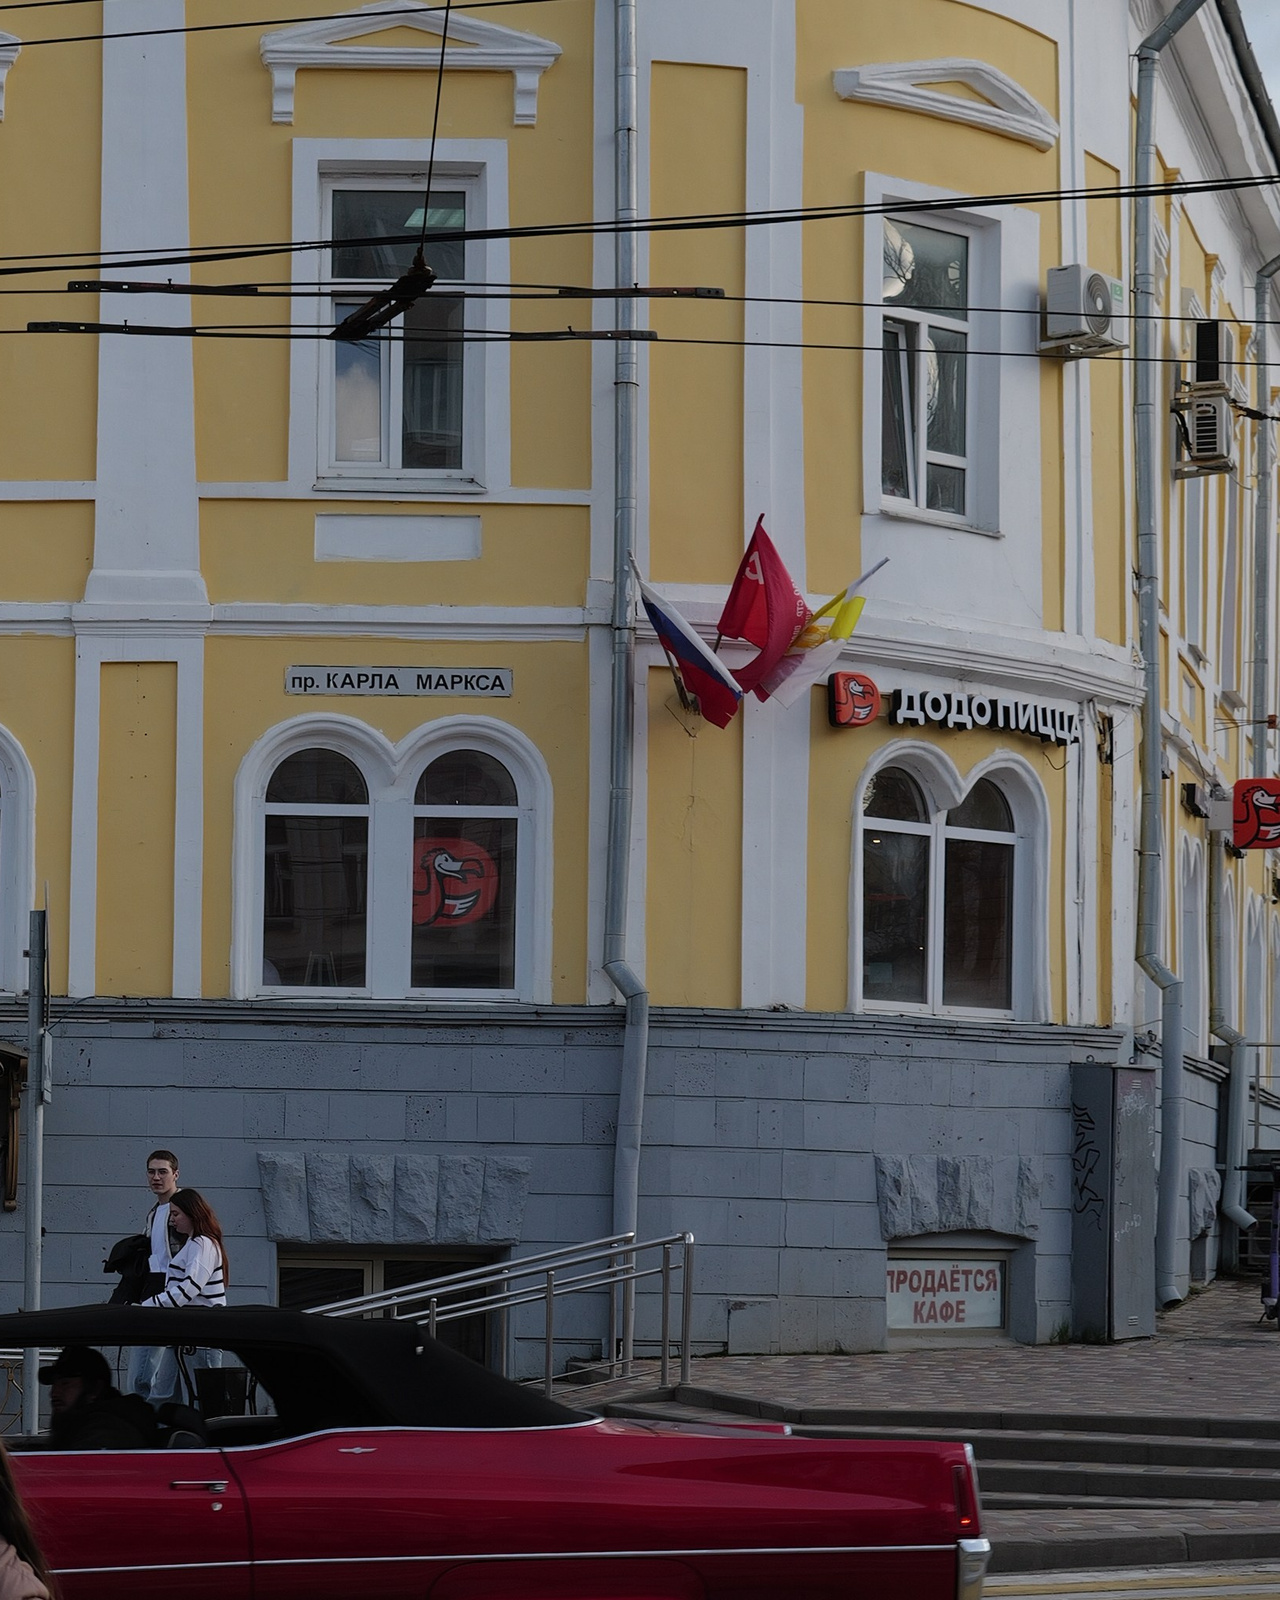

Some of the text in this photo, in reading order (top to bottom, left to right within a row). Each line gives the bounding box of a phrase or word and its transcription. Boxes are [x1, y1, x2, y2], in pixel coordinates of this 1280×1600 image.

[291, 673, 506, 692] пр. КАРЛА МАРКСА
[895, 688, 1081, 744] ДОДО ПИЦЦА
[886, 1264, 998, 1298] ПРОДАЁТСЯ
[913, 1300, 966, 1324] КАФЕ
